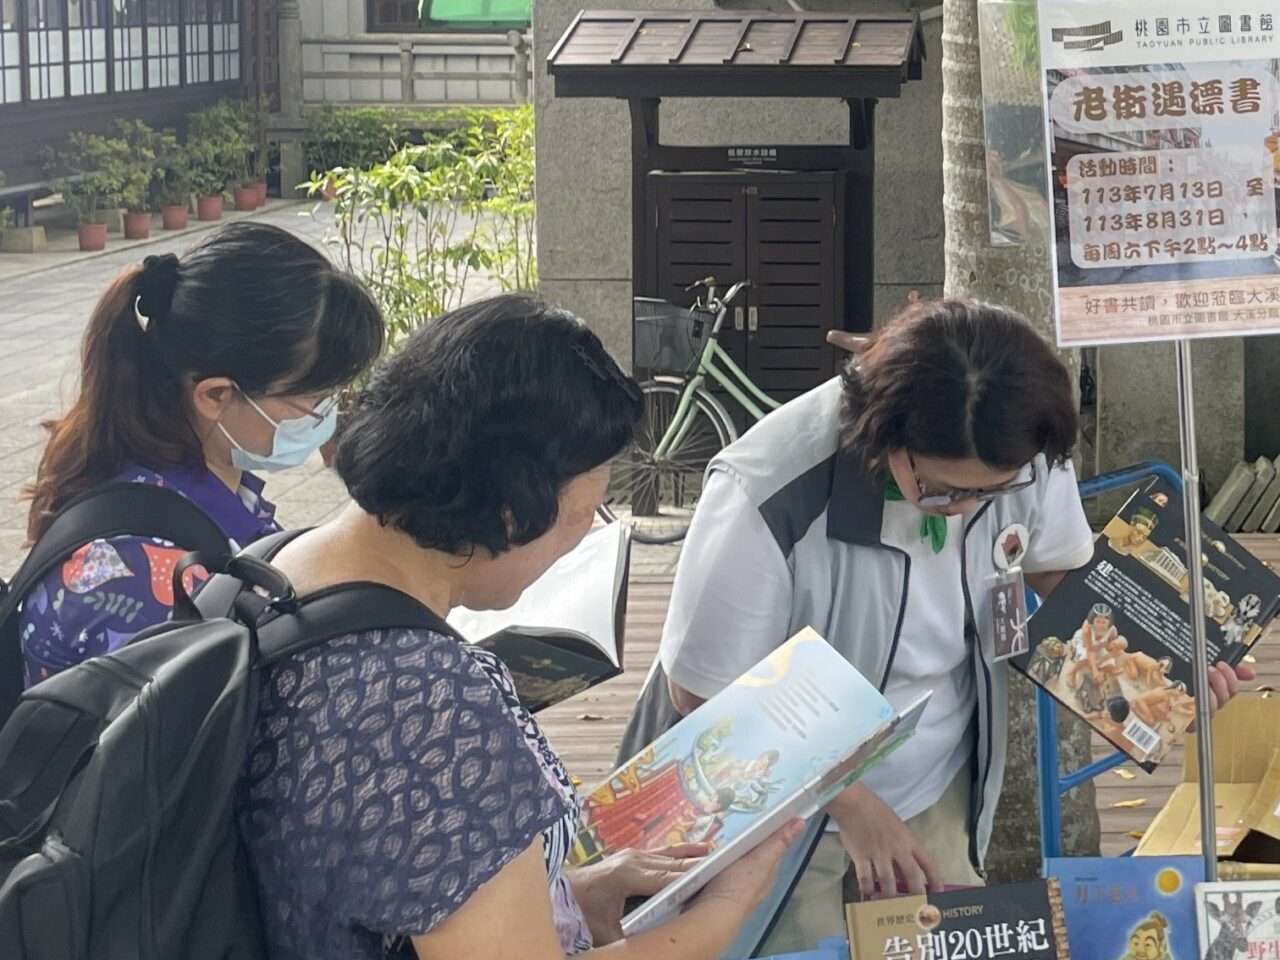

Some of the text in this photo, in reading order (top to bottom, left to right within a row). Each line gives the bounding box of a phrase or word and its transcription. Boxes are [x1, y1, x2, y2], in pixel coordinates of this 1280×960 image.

[1135, 14, 1273, 37] 桃園市立圖書館
[1136, 35, 1274, 48] TAOYUAN PUBLIC LIBRARY
[1082, 178, 1265, 205] 113年7月13日 至
[942, 904, 985, 920] HISTORY
